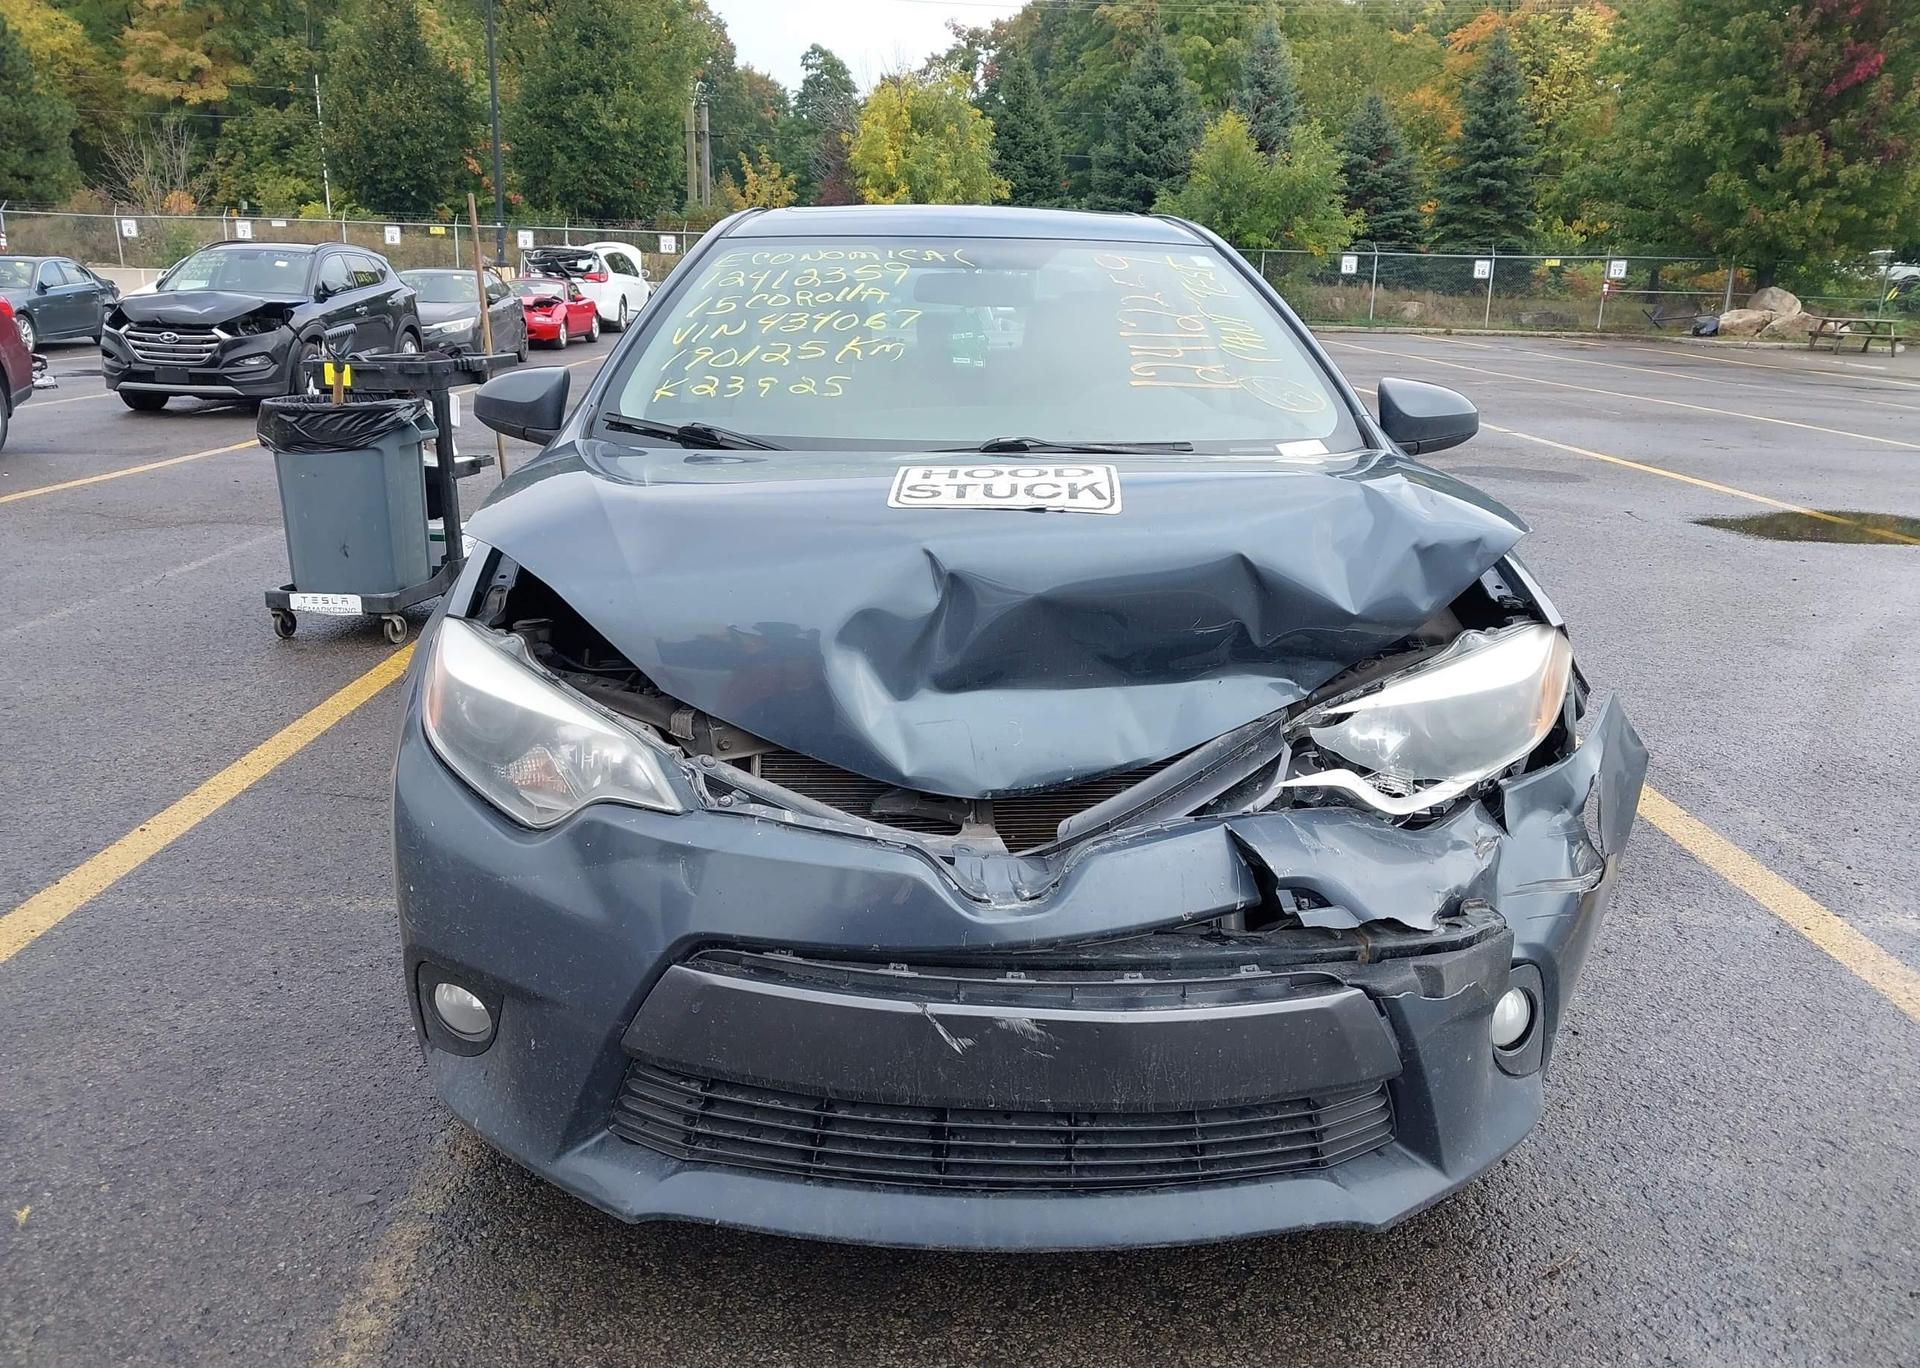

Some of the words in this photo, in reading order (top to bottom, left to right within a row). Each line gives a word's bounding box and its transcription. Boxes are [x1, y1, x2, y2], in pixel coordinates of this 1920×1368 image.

[663, 243, 673, 251] 10
[1344, 264, 1354, 272] 15
[1477, 268, 1487, 276] 16
[1612, 268, 1623, 276] 17
[701, 262, 911, 293] 12412359
[672, 319, 747, 346] VIN
[921, 467, 1095, 480] HOOD
[903, 481, 1108, 501] STUCK
[300, 596, 349, 605] TESLA
